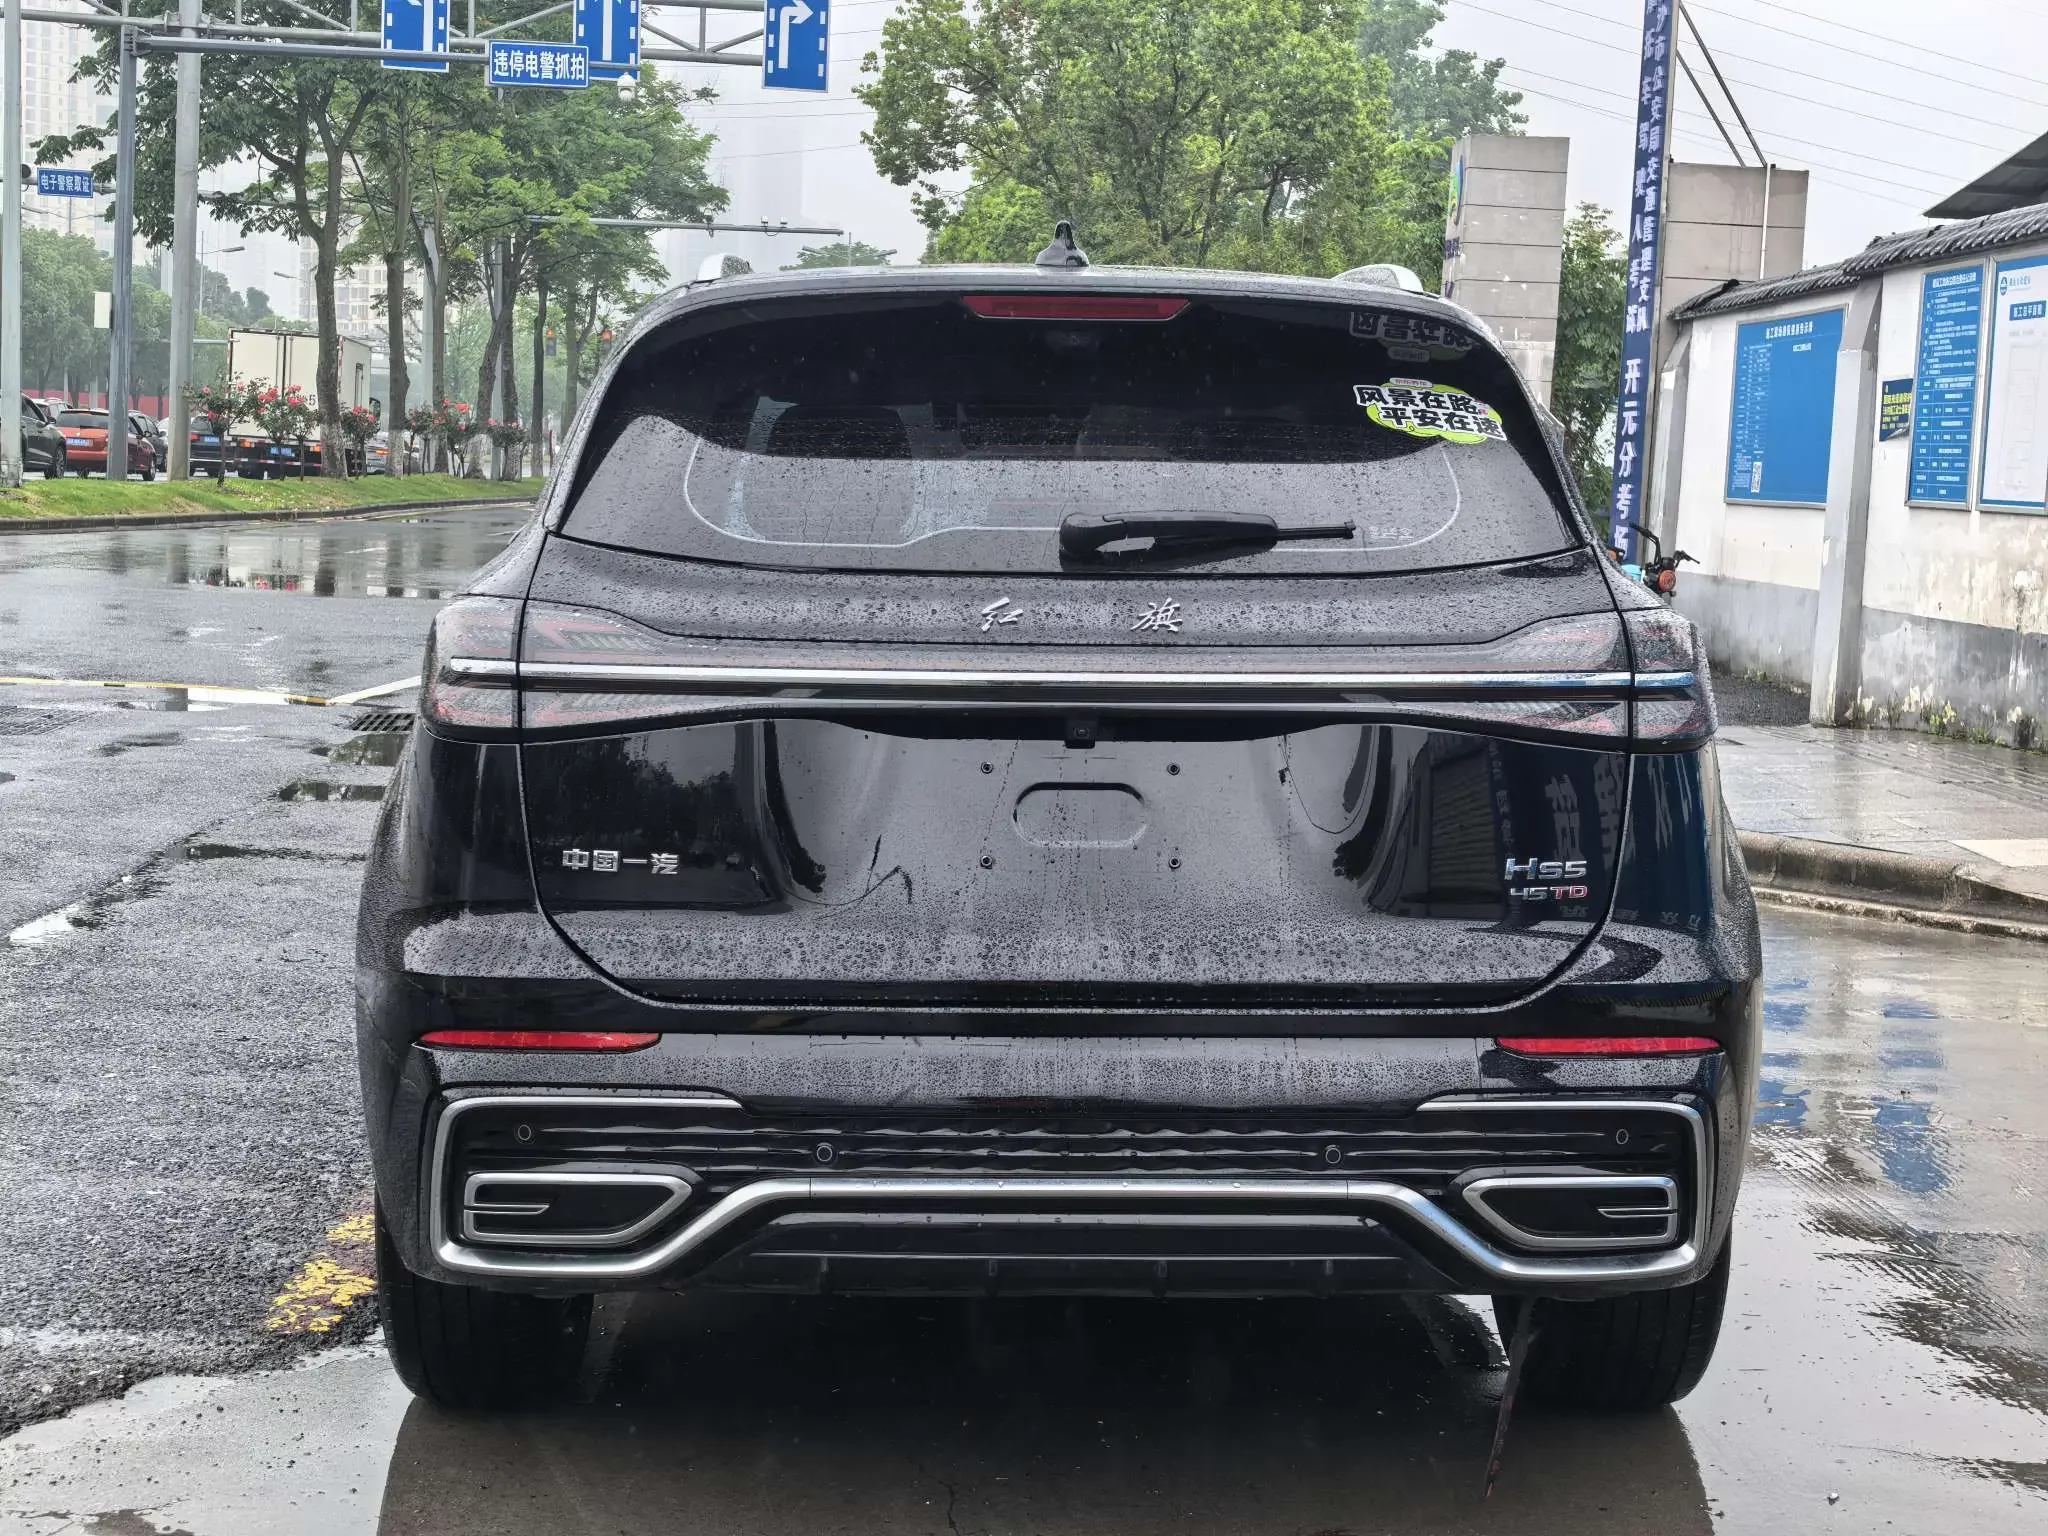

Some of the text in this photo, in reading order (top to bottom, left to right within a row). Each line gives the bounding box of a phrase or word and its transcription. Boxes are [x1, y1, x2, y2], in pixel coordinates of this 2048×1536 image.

[494, 51, 585, 81] 违停电警抓拍
[41, 174, 91, 193] 电子警察取证
[1614, 358, 1641, 561] 开元分考场
[981, 596, 1183, 633] 红旗
[562, 848, 679, 874] 中国一汽
[1503, 858, 1587, 881] HS5
[1510, 885, 1588, 900] 45TD
